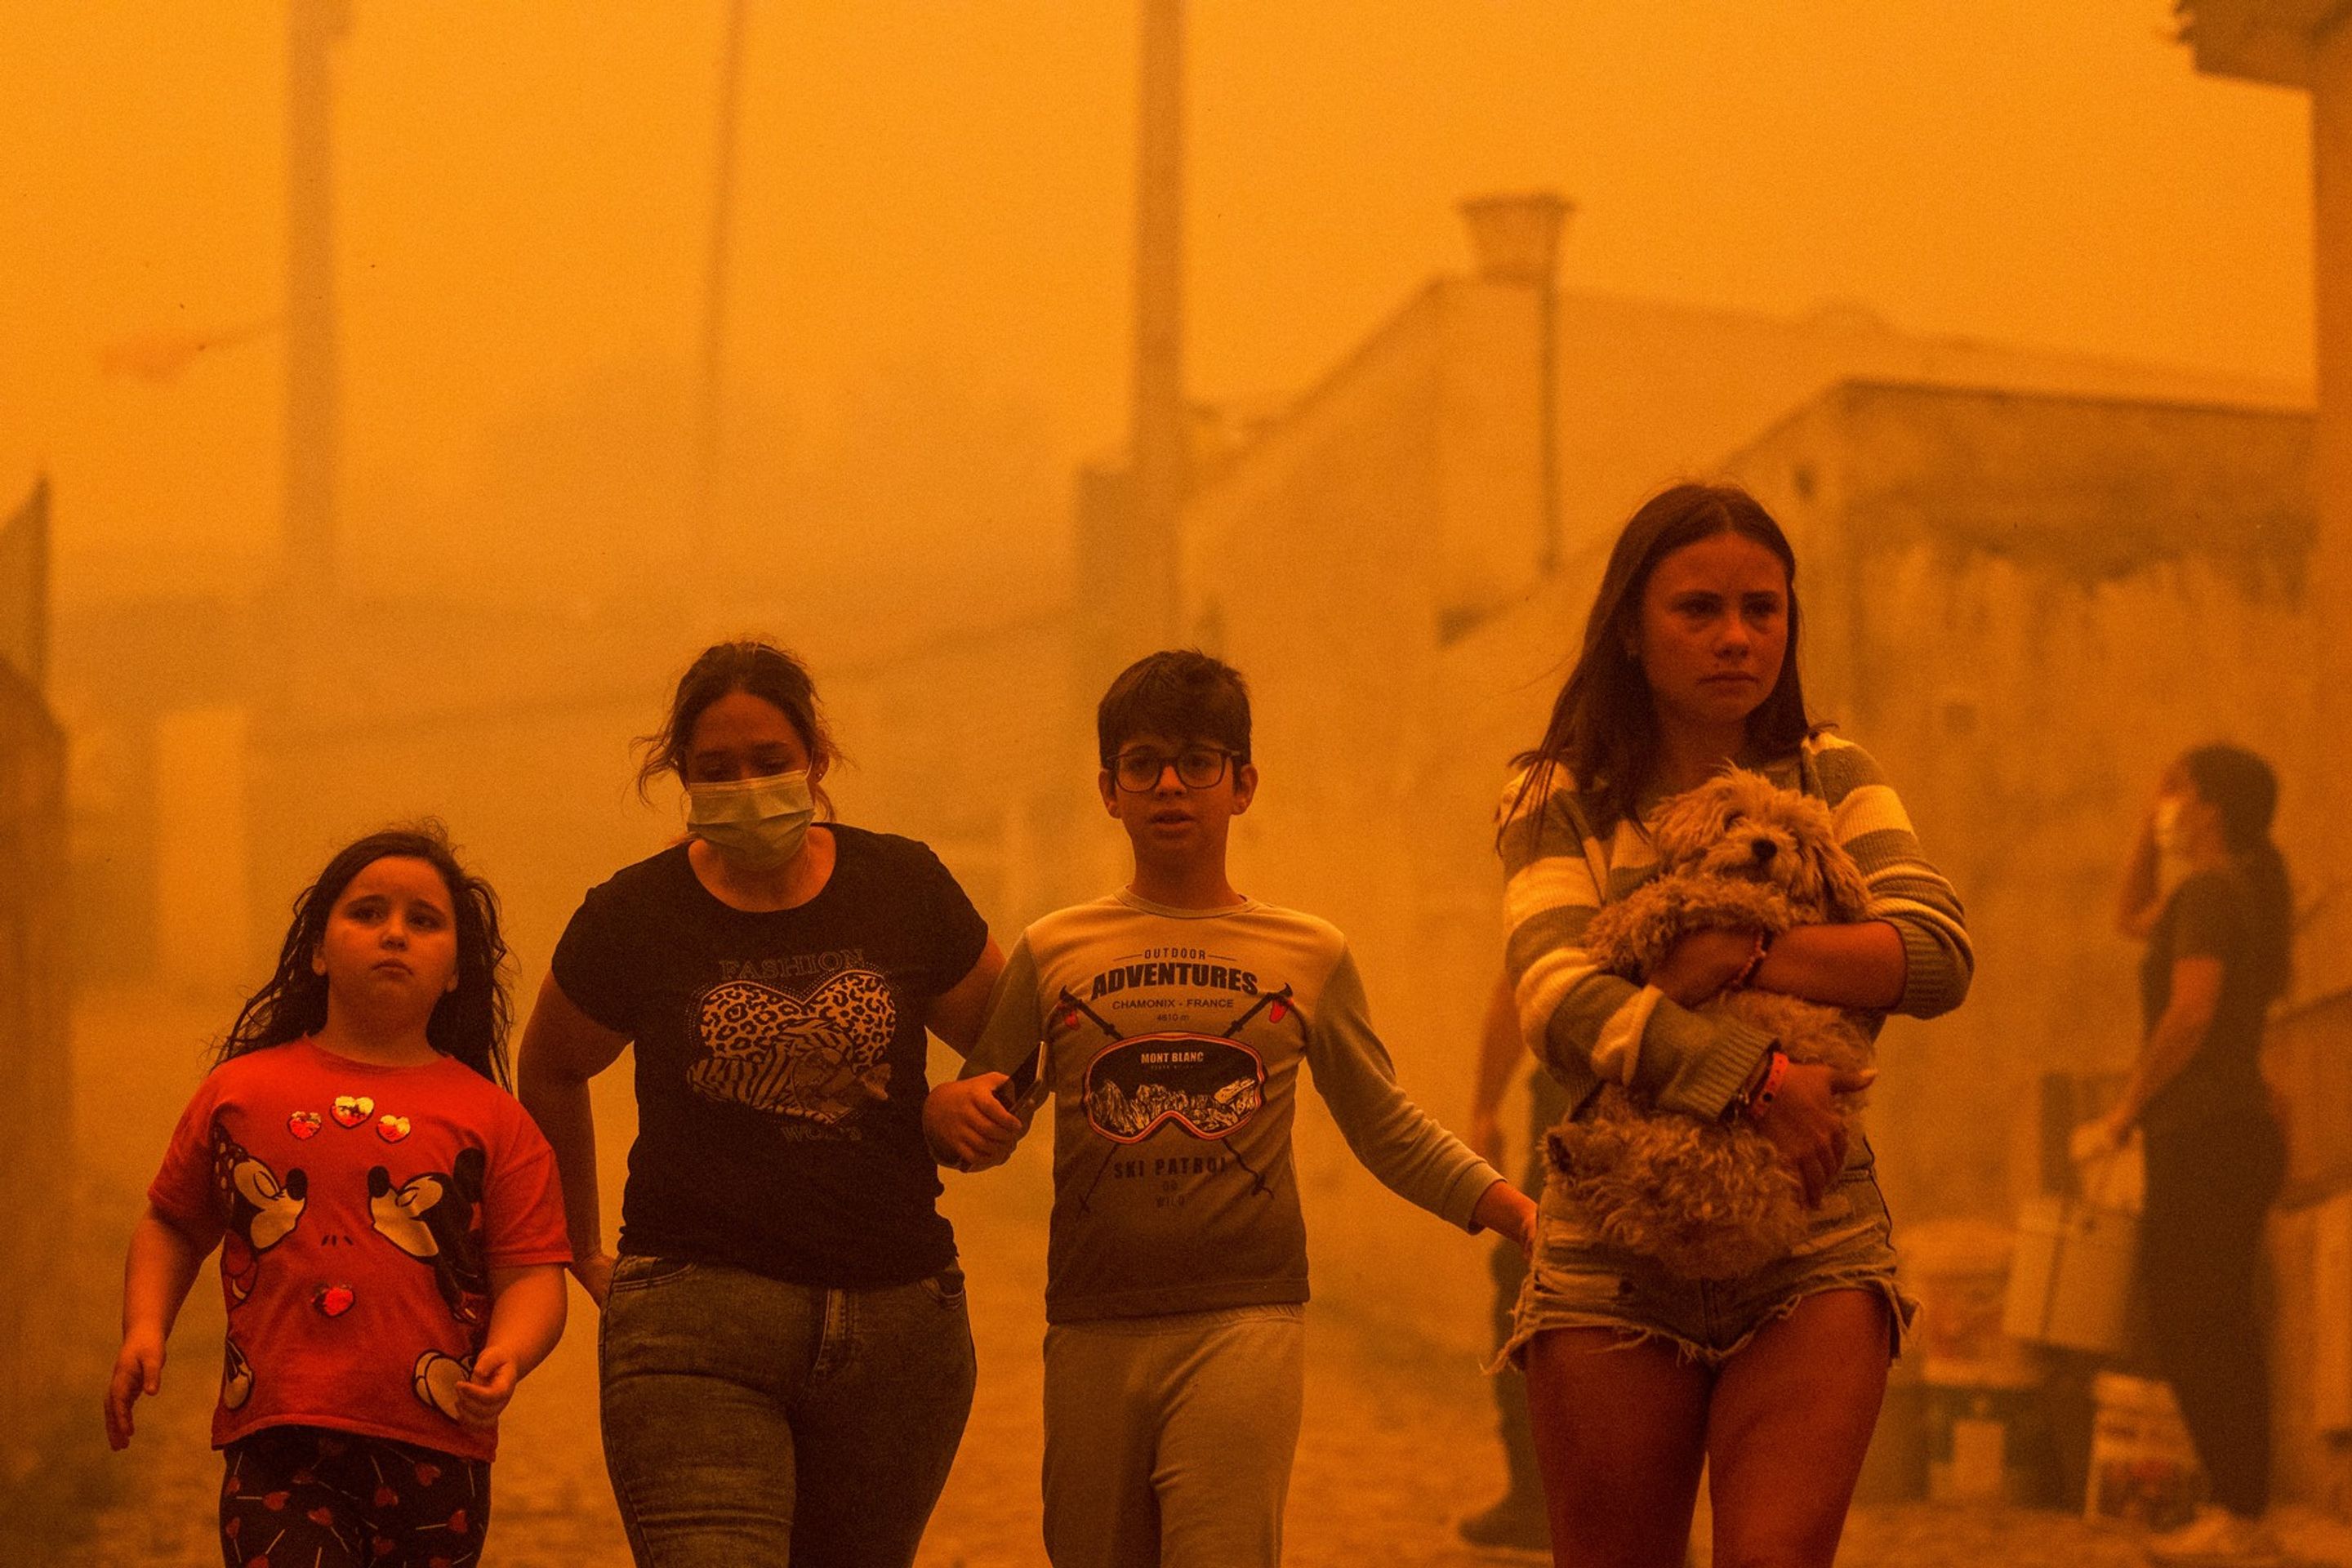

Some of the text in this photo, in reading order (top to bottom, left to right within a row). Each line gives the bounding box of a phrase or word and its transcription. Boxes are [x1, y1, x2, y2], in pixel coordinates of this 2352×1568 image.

[1144, 947, 1206, 960] OUTDOOR
[719, 948, 865, 981] FASHION
[1090, 962, 1258, 1001] ADVENTURES
[1112, 999, 1175, 1009] CHAMONIX
[1187, 999, 1234, 1008] FRANCE
[1141, 1051, 1204, 1063] MONT BLANC
[1114, 1160, 1143, 1178] SKI
